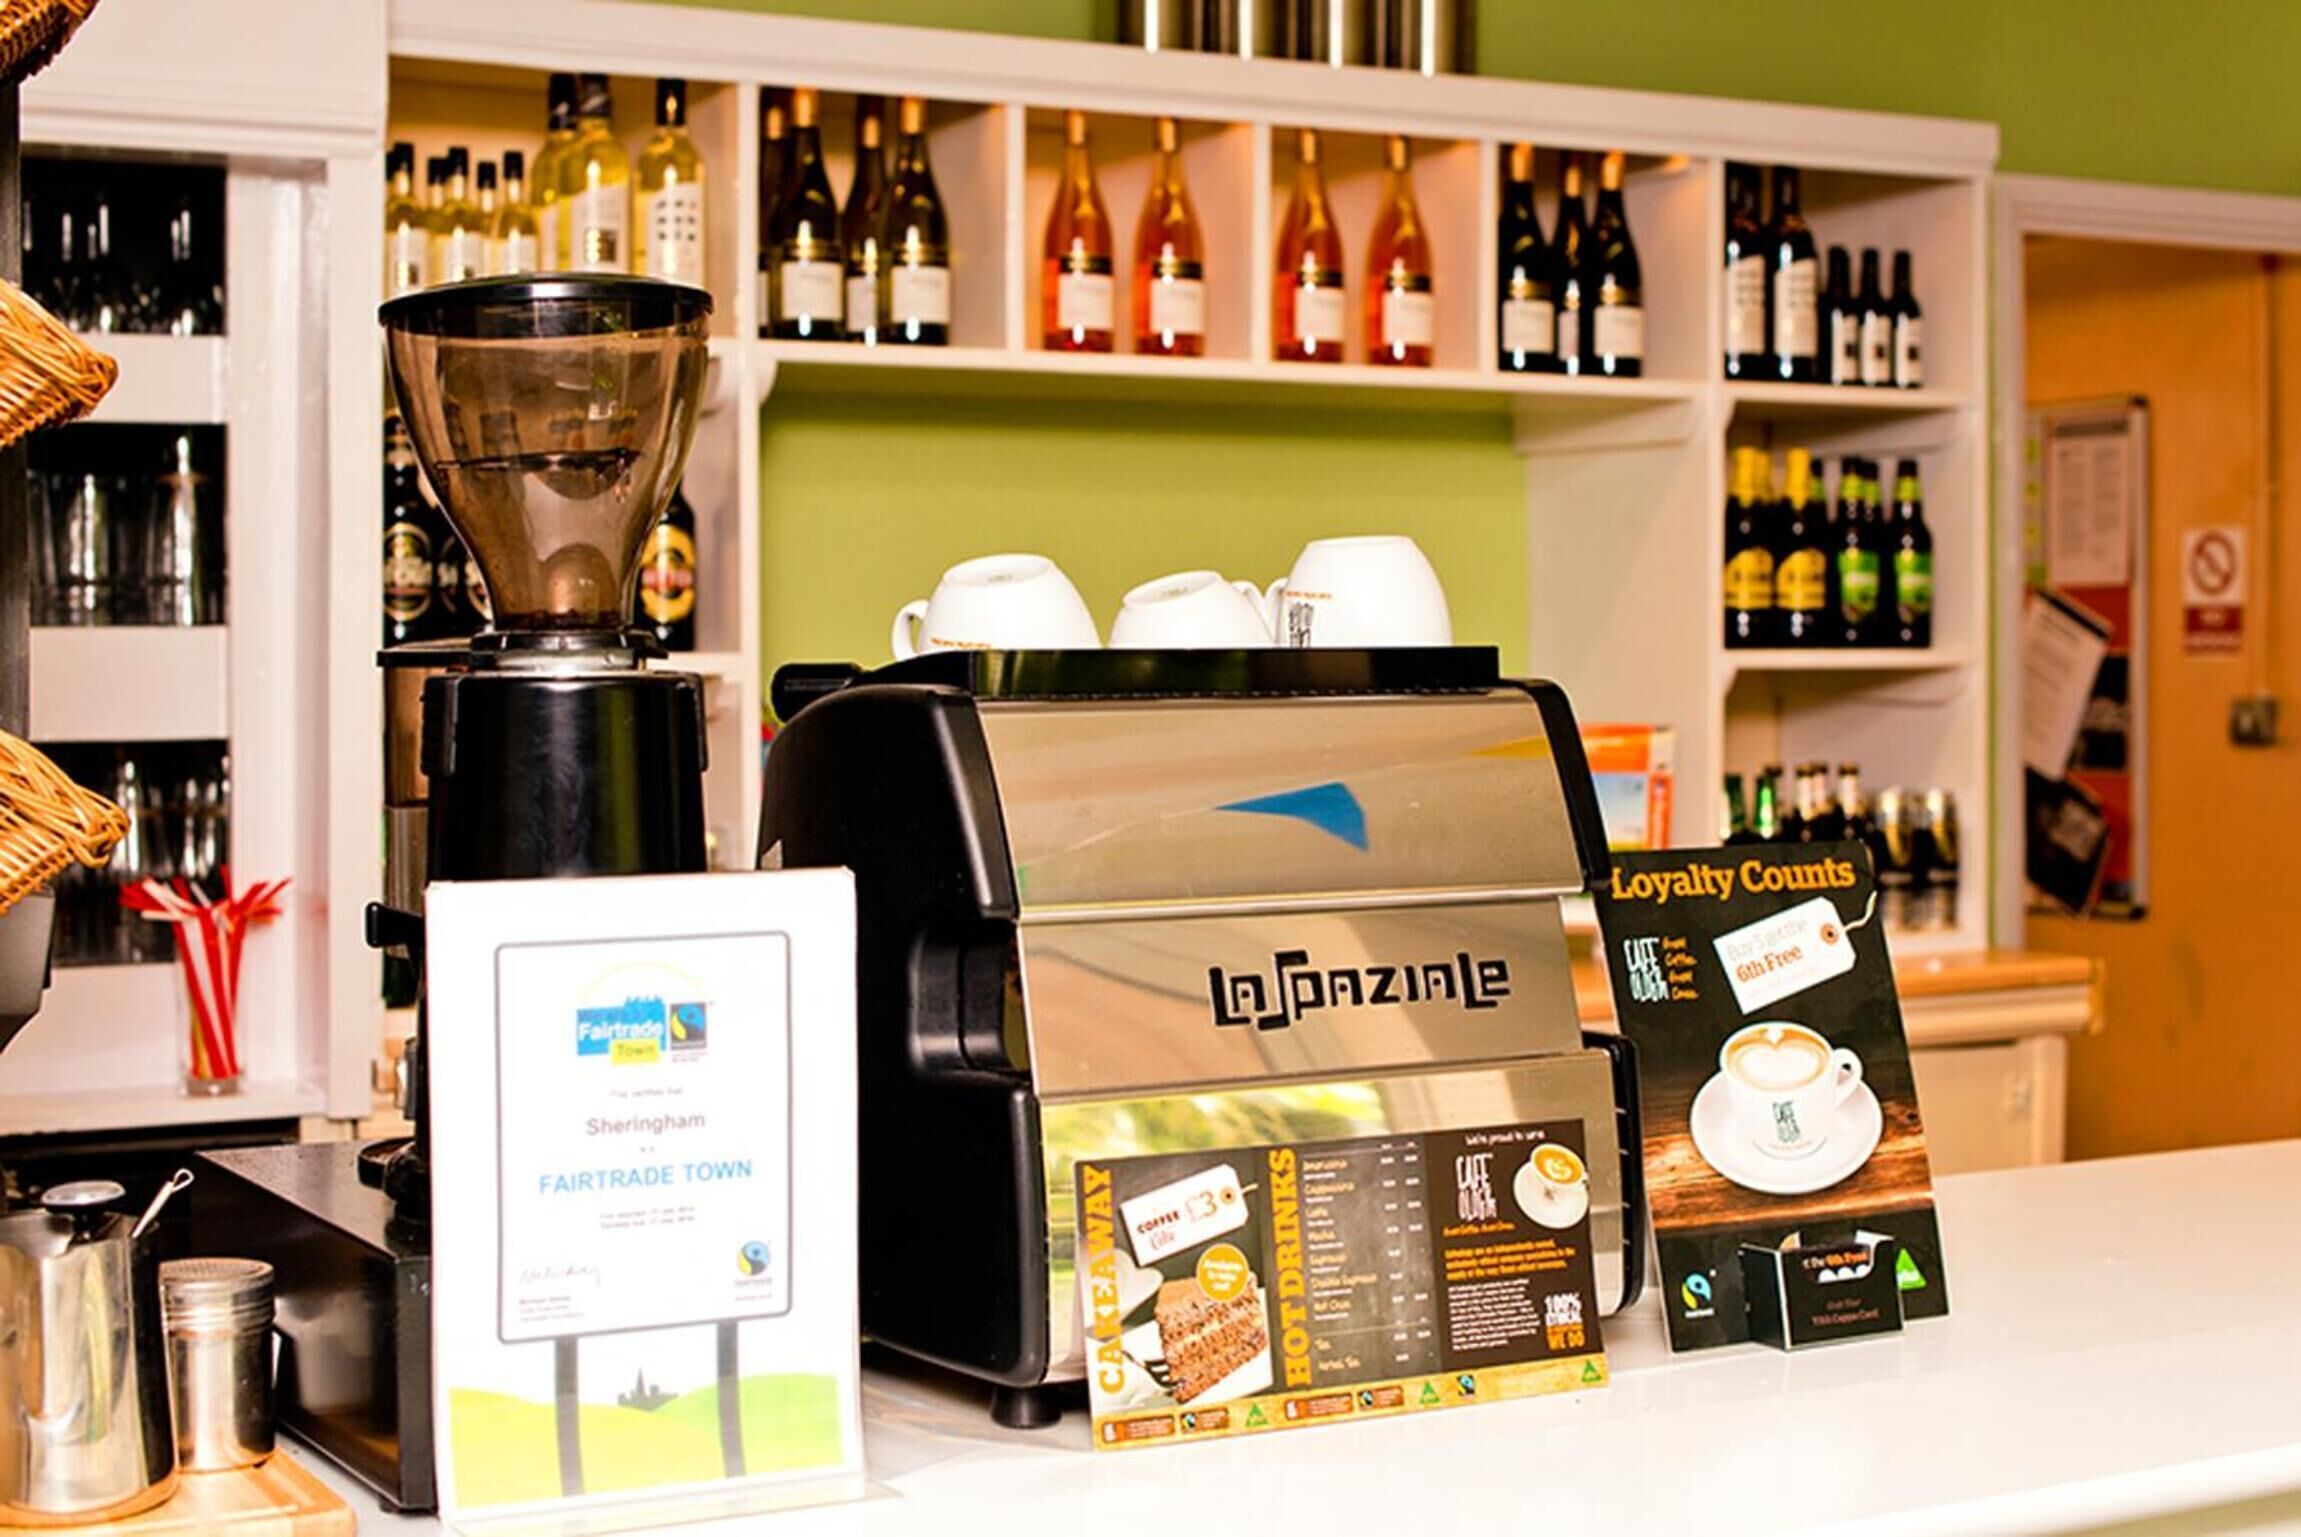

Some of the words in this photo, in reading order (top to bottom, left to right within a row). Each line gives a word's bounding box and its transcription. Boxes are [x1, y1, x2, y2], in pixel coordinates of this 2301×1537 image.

[1610, 863, 1736, 905] Loyalty
[1739, 857, 1856, 893] Counts
[1735, 958, 1766, 983] 6th
[1763, 945, 1804, 972] Free
[578, 1020, 665, 1042] Fairtrade
[616, 1043, 655, 1058] Town
[586, 1112, 706, 1136] Sheringham
[538, 1165, 674, 1194] FAIRTRADE
[685, 1159, 753, 1183] TOWN
[1136, 1210, 1181, 1234] COFFEE
[1268, 1147, 1306, 1298] DRINKS
[1082, 1164, 1125, 1393] CAKEAWAY
[1279, 1301, 1313, 1388] HOT
